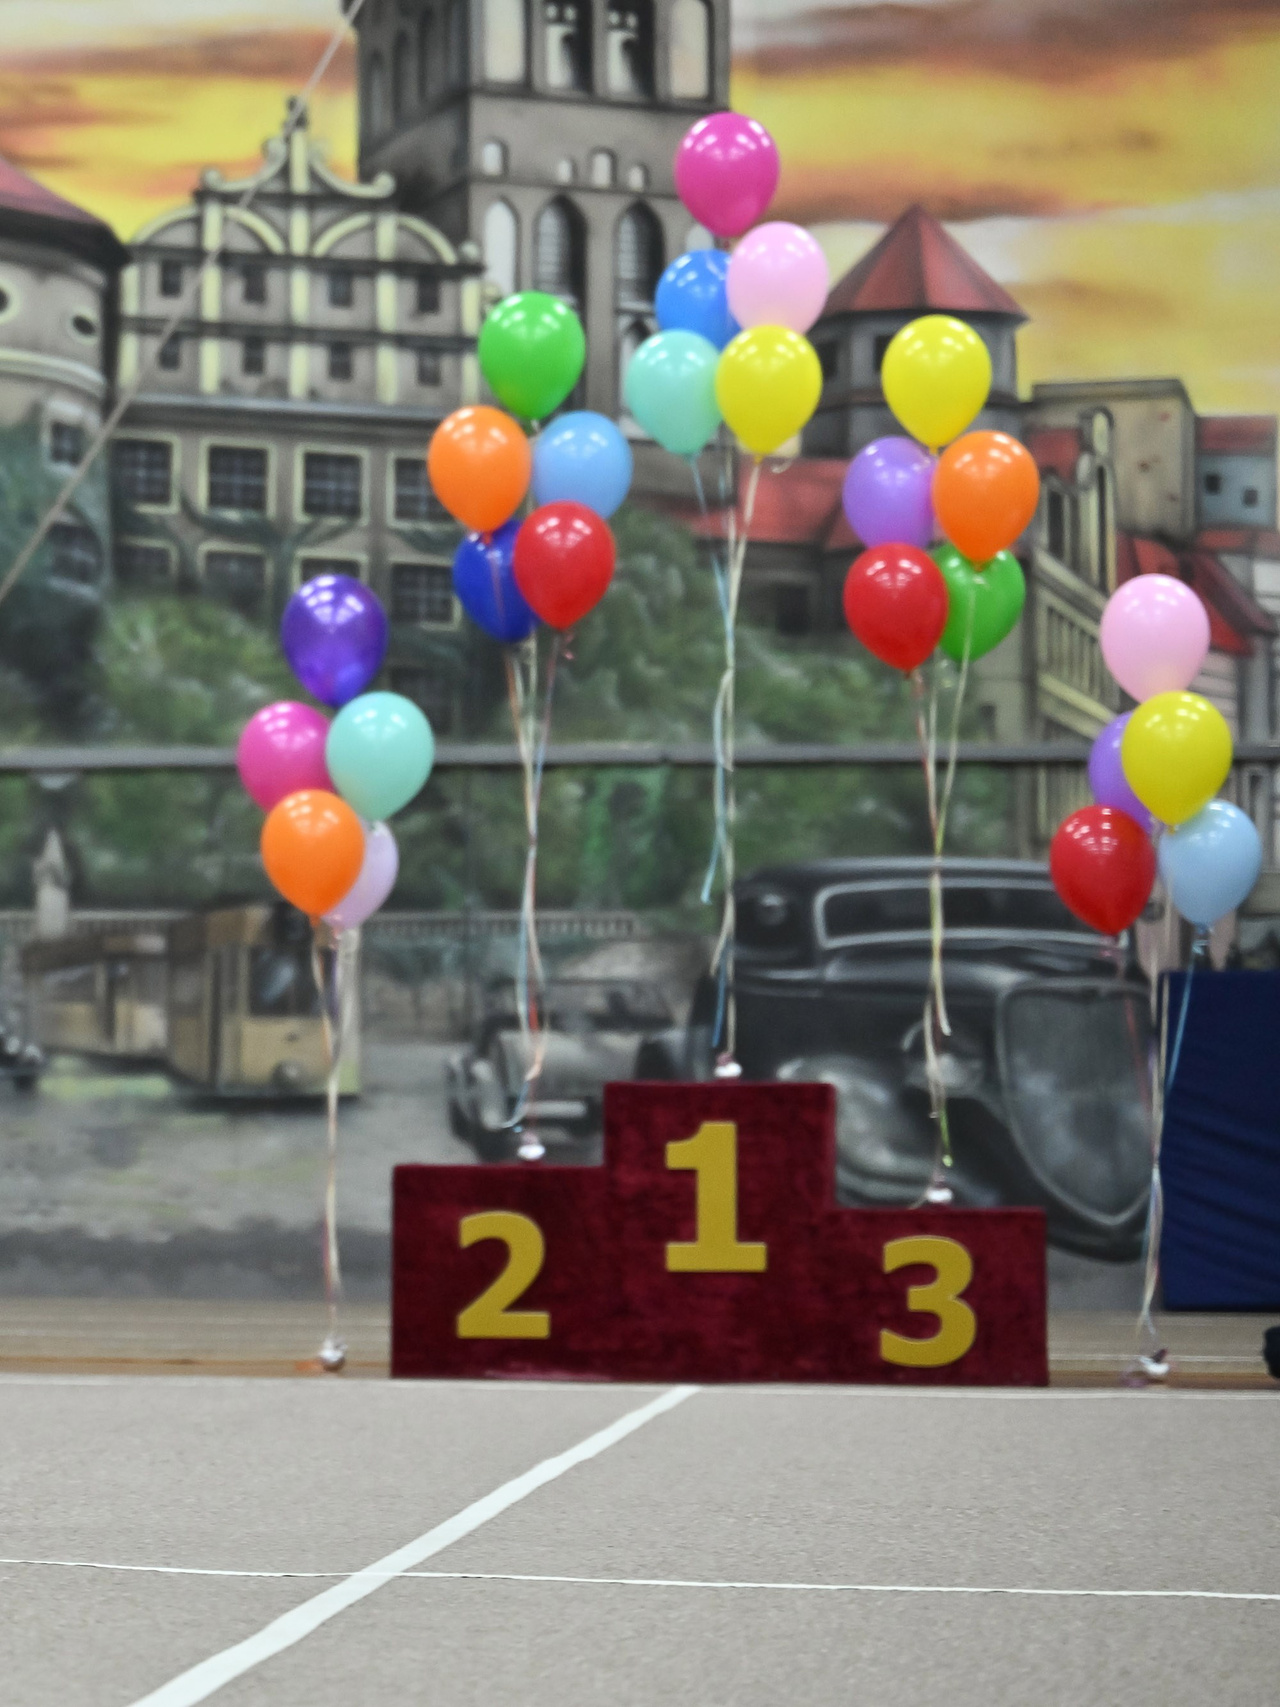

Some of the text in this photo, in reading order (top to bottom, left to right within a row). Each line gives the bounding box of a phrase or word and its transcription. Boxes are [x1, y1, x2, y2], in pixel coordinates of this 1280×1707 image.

[665, 1121, 767, 1272] 1
[457, 1211, 550, 1339] 2
[880, 1235, 977, 1367] 3
